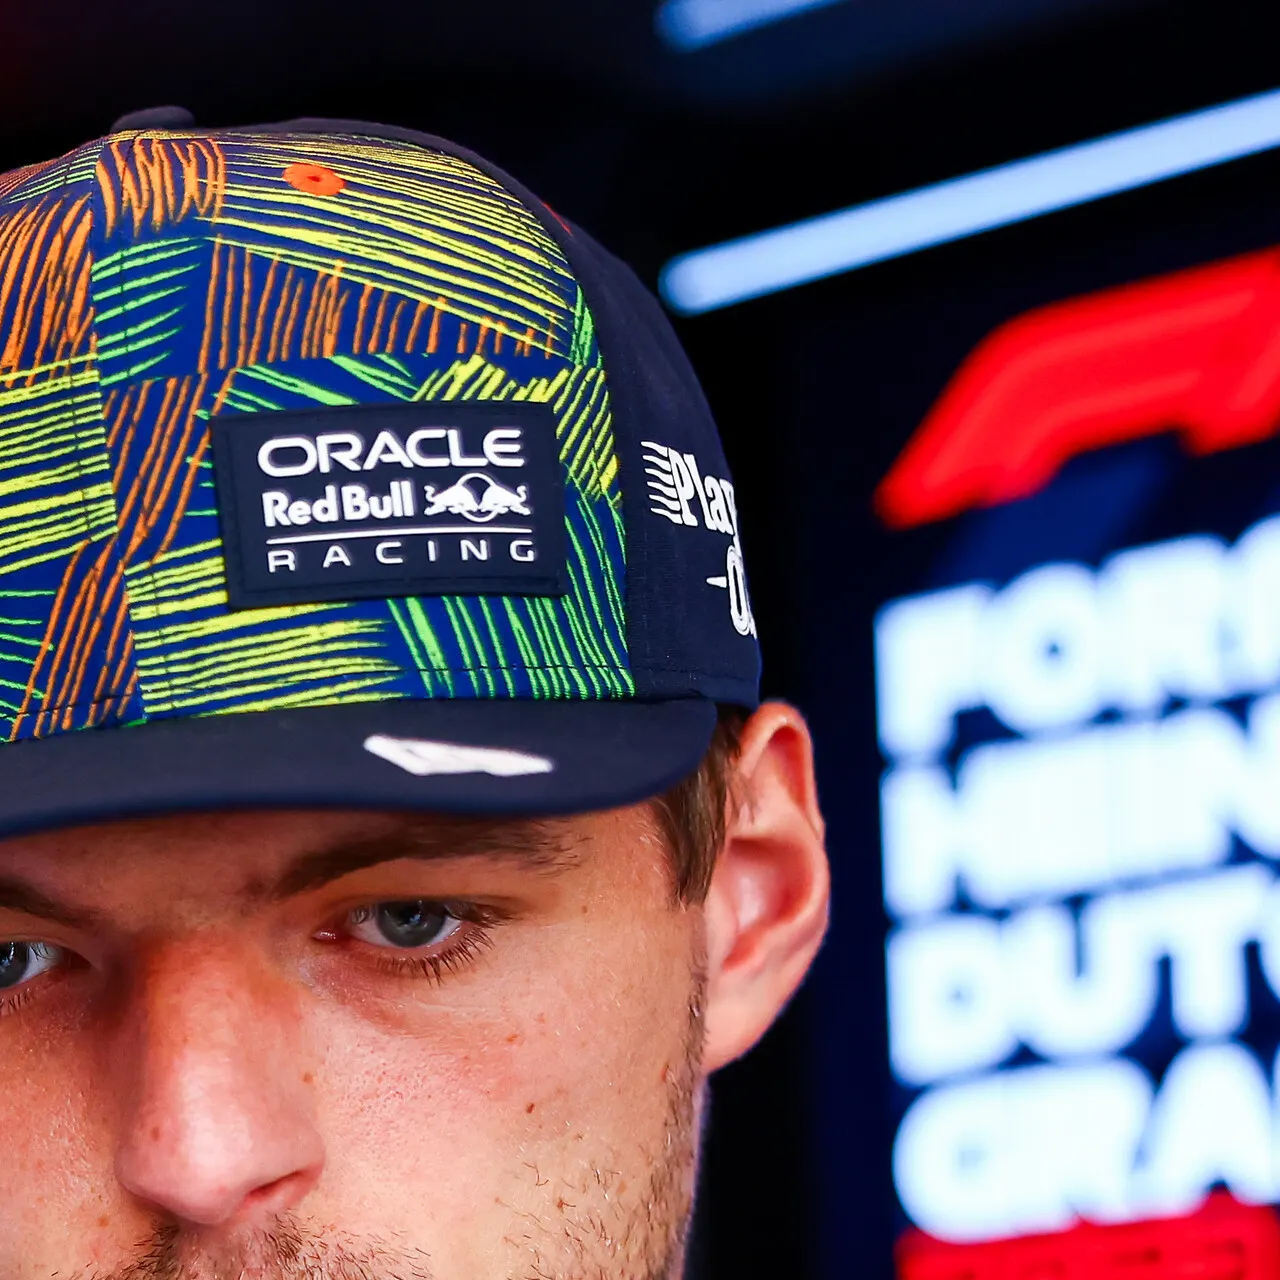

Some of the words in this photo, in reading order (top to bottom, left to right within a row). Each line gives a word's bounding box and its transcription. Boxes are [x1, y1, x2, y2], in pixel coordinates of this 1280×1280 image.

[257, 429, 525, 477] ORACLE
[262, 485, 338, 527] Red
[341, 480, 415, 521] Bull
[267, 540, 535, 573] RACING
[888, 862, 1280, 1088] DUT
[892, 1040, 1280, 1244] GRA
